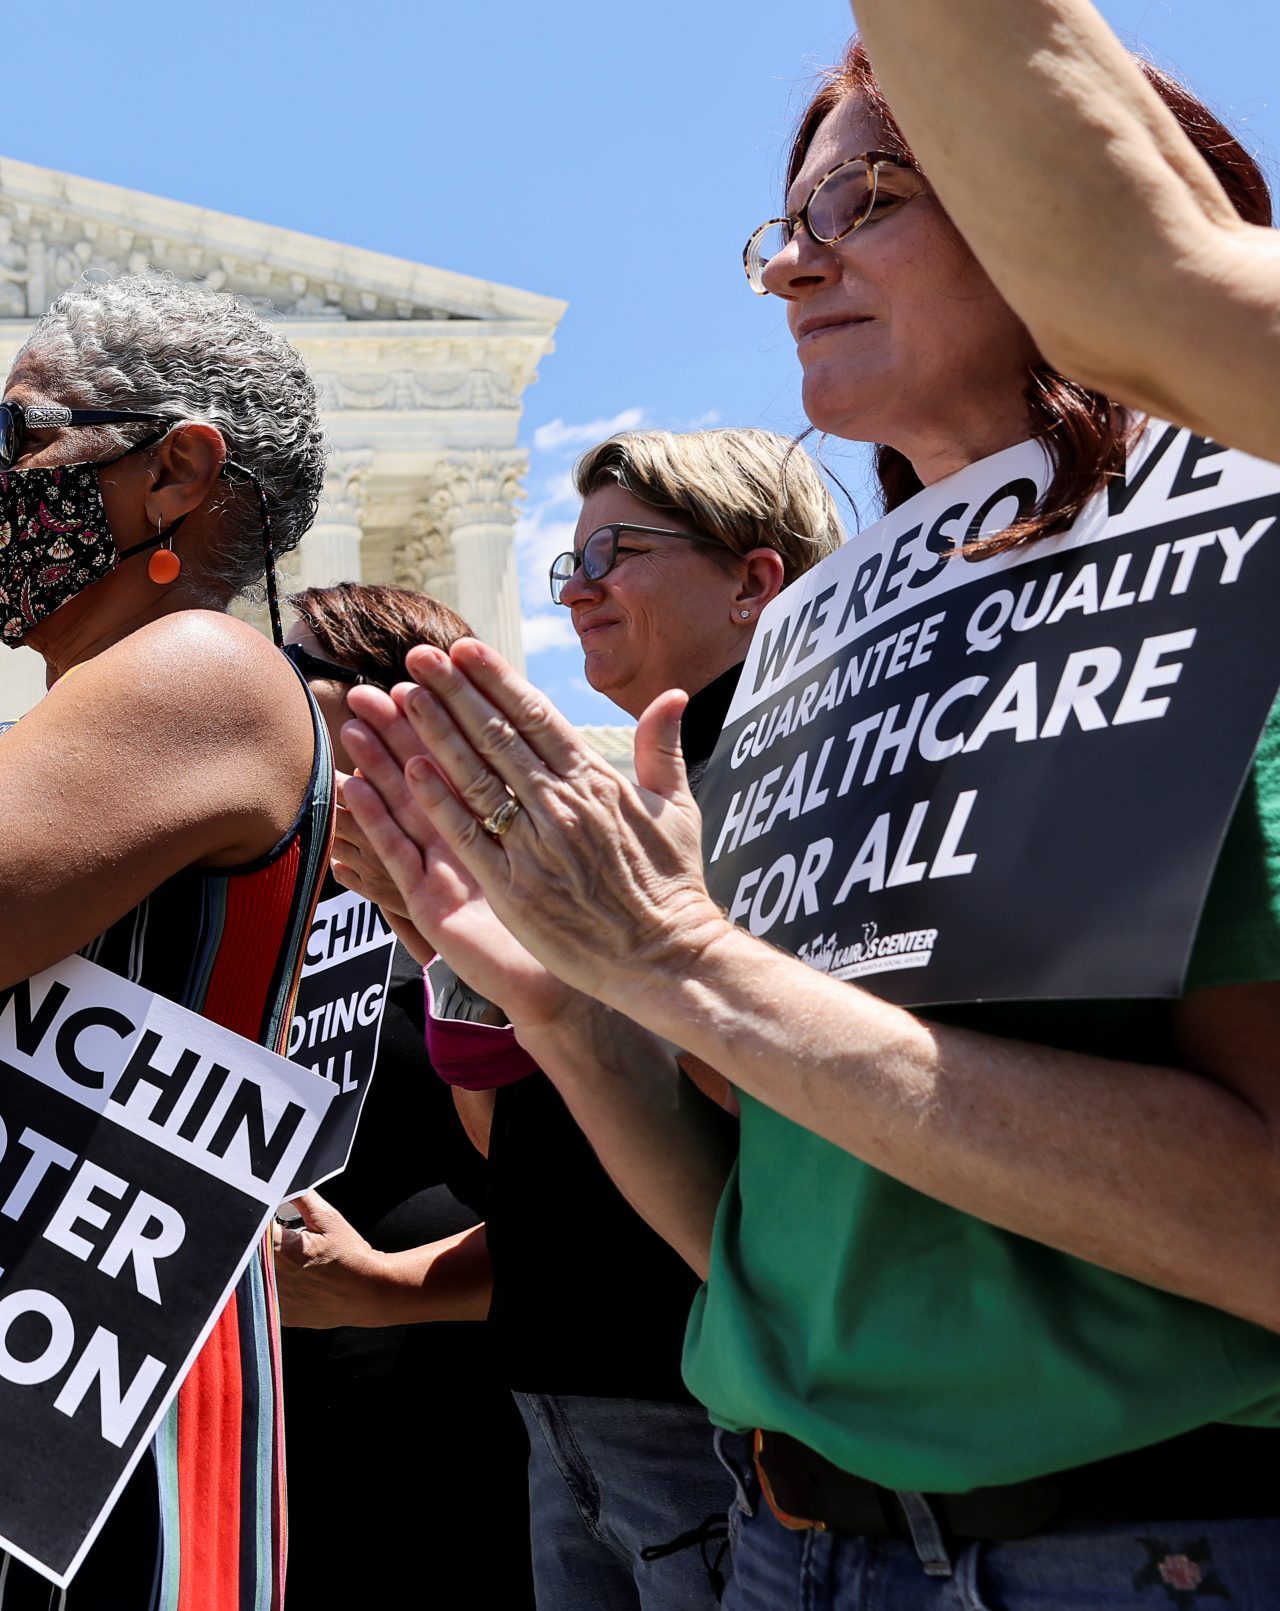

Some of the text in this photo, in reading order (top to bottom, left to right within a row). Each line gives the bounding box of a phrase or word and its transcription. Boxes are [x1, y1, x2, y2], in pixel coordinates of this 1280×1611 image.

[729, 516, 1277, 769] GUARANTEE QUALITY
[751, 424, 1233, 696] WE RESOVE
[710, 628, 1197, 864] HEALTHCARE
[728, 789, 978, 937] FOR ALL
[878, 928, 938, 956] CENTER
[289, 983, 384, 1057] OTING
